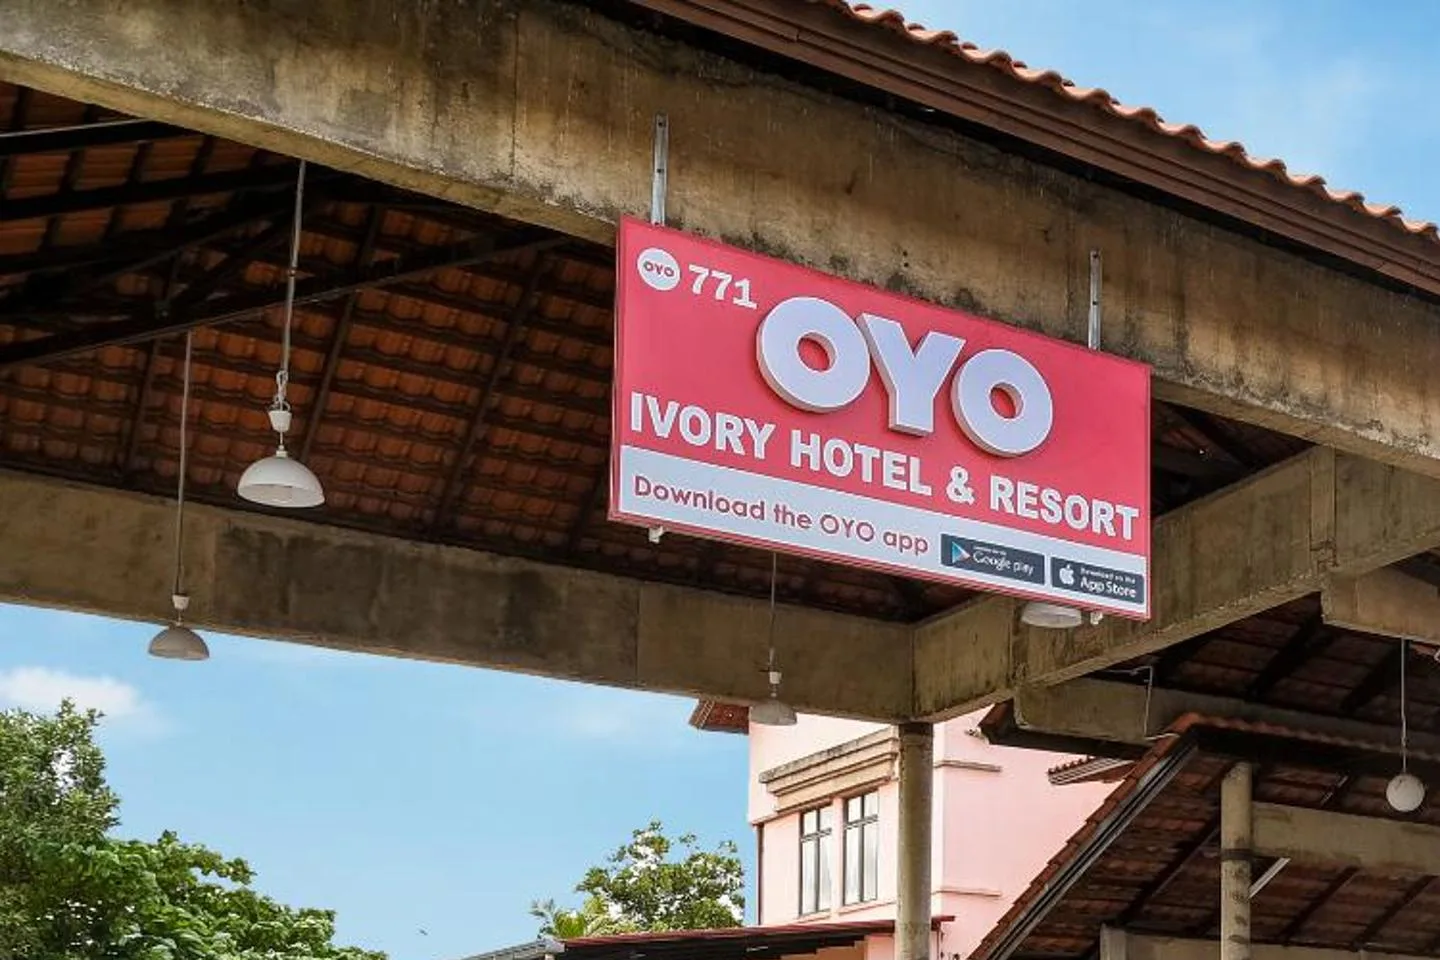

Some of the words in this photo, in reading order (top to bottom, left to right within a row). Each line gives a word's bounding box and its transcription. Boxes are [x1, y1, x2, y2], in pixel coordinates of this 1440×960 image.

[643, 260, 675, 278] OYO
[688, 263, 758, 310] 771
[756, 296, 1054, 458] OYO
[631, 391, 776, 460] IVORY
[790, 429, 932, 497] HOTEL
[946, 466, 975, 505] &
[989, 475, 1140, 541] RESORT
[634, 474, 765, 521] Download
[774, 503, 812, 530] the
[820, 513, 875, 542] OYO
[883, 531, 928, 556] app
[973, 551, 1011, 572] Google
[1080, 576, 1105, 594] App
[1105, 581, 1137, 598] Store
